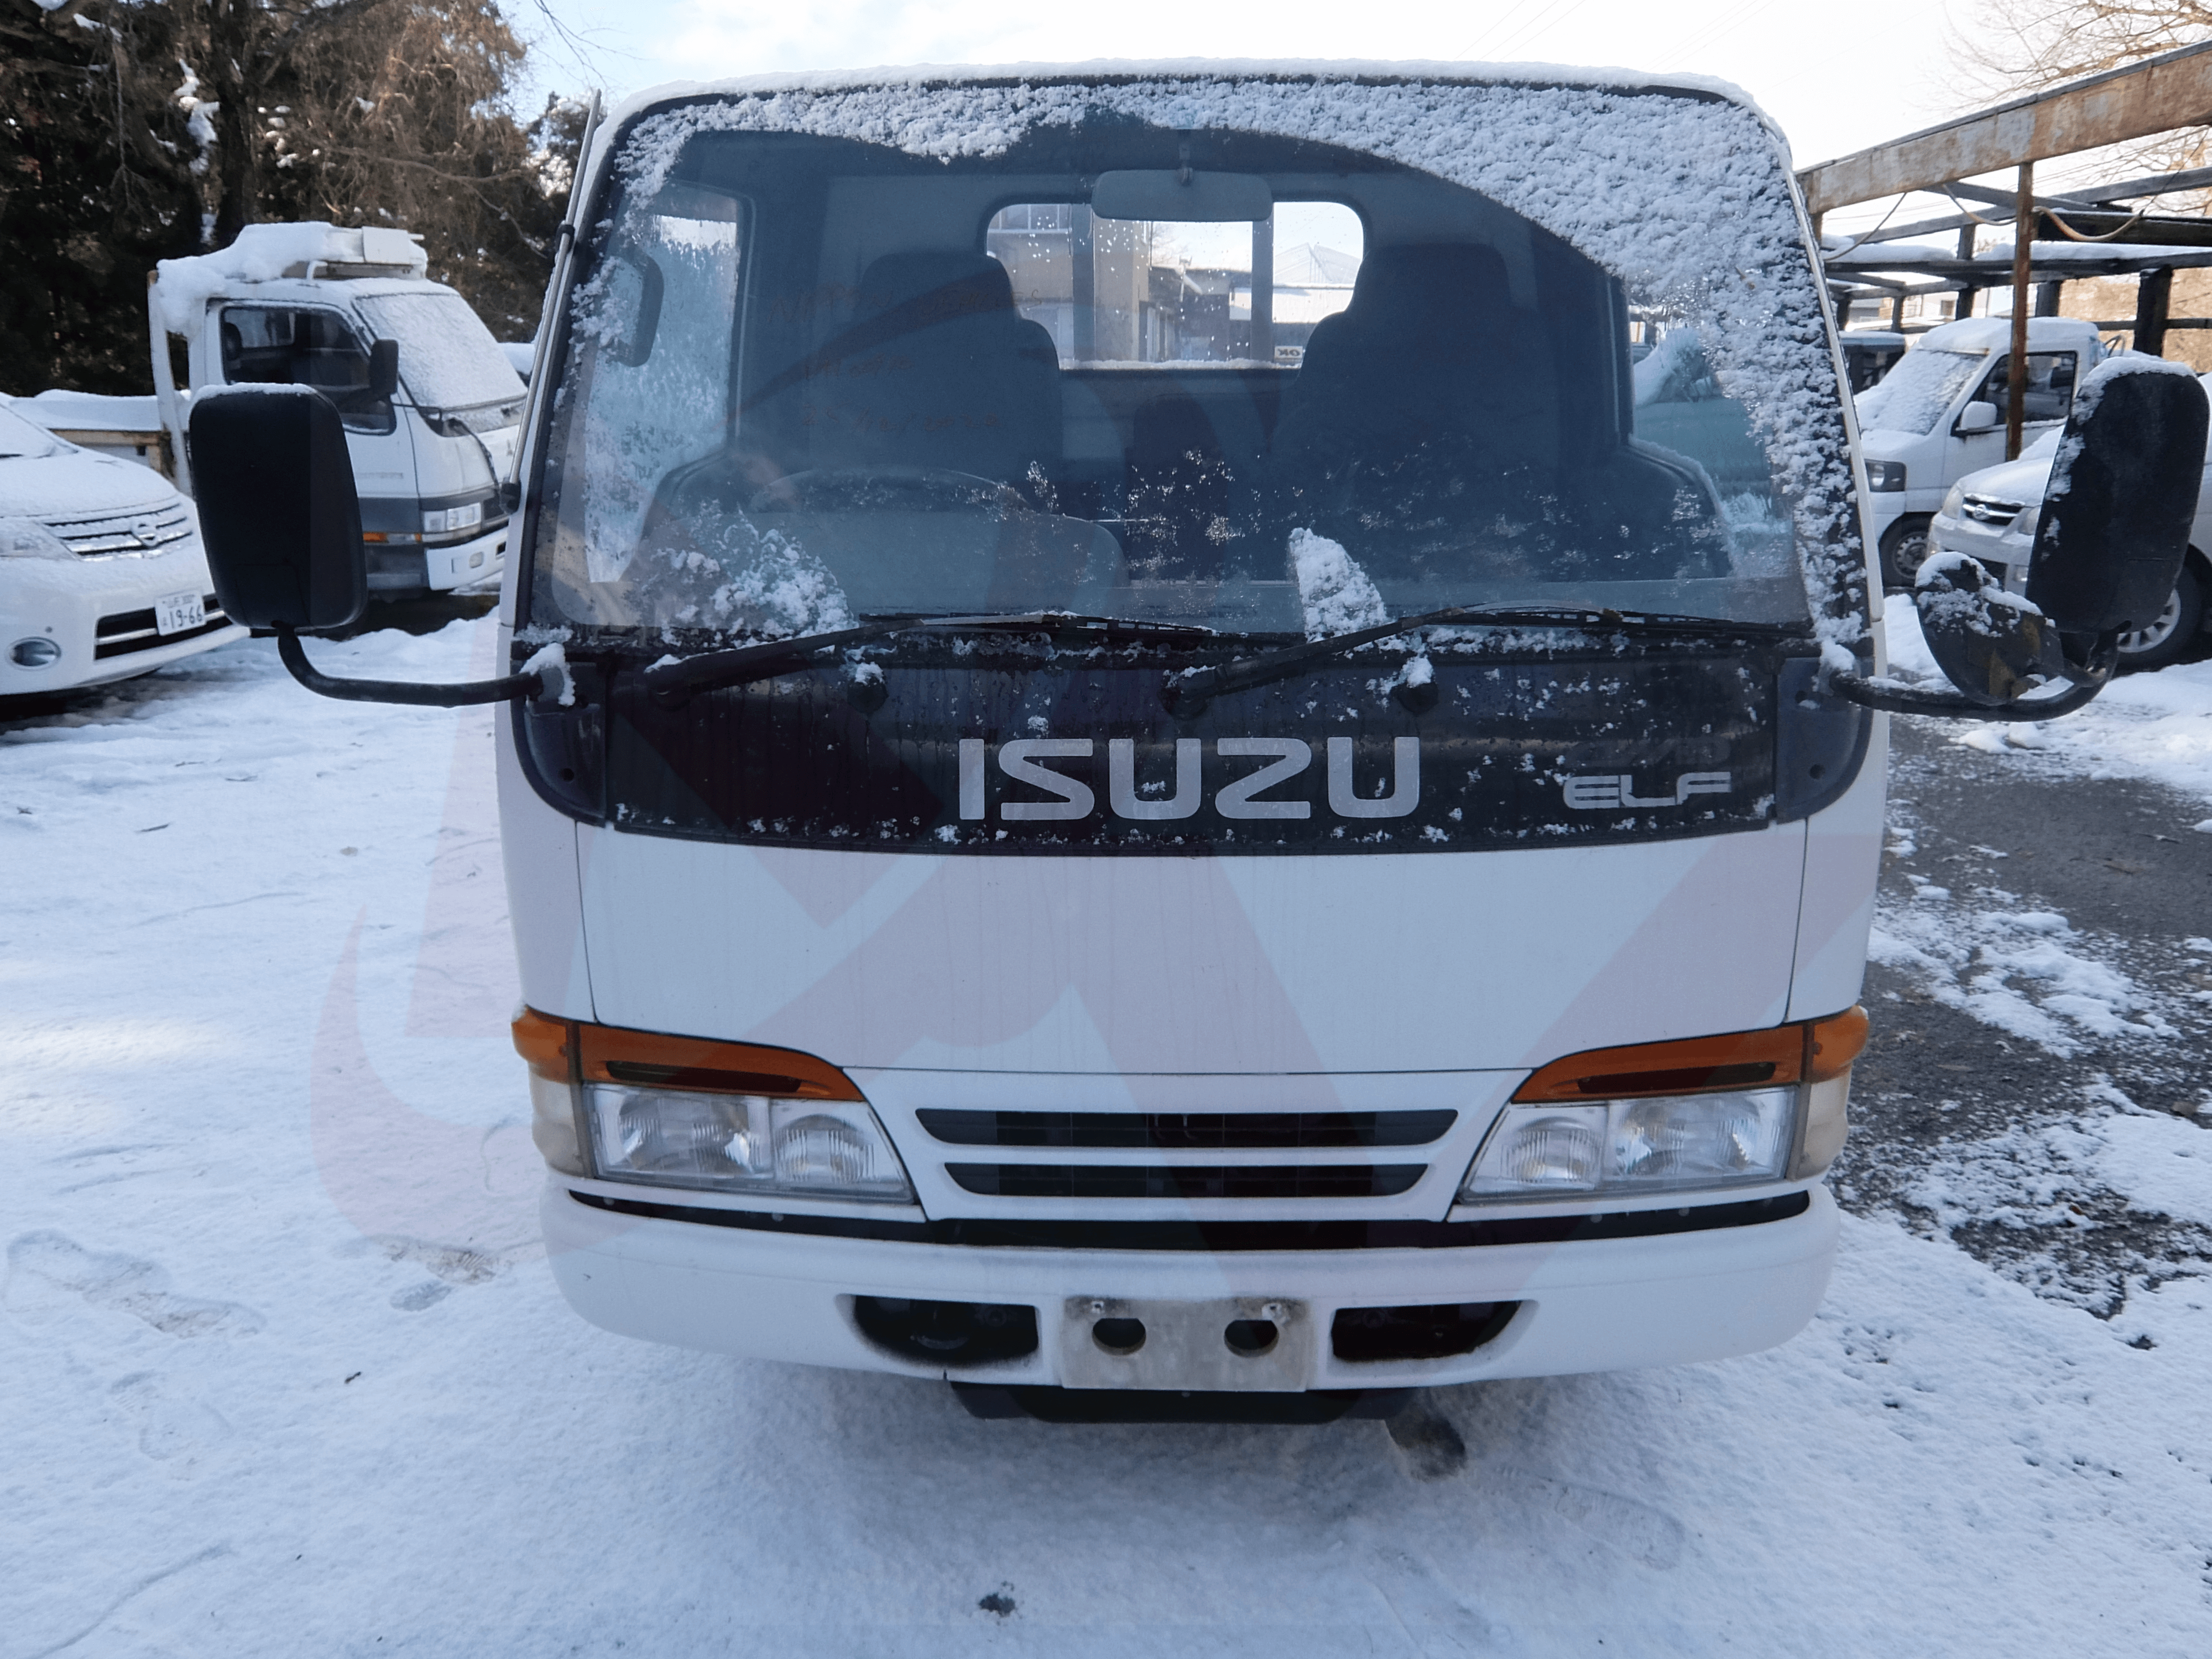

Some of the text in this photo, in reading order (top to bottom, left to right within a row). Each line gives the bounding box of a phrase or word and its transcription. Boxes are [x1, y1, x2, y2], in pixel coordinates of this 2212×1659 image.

[169, 604, 202, 629] 19-66
[958, 737, 1420, 821] ISUZU
[1563, 771, 1731, 809] ELF
